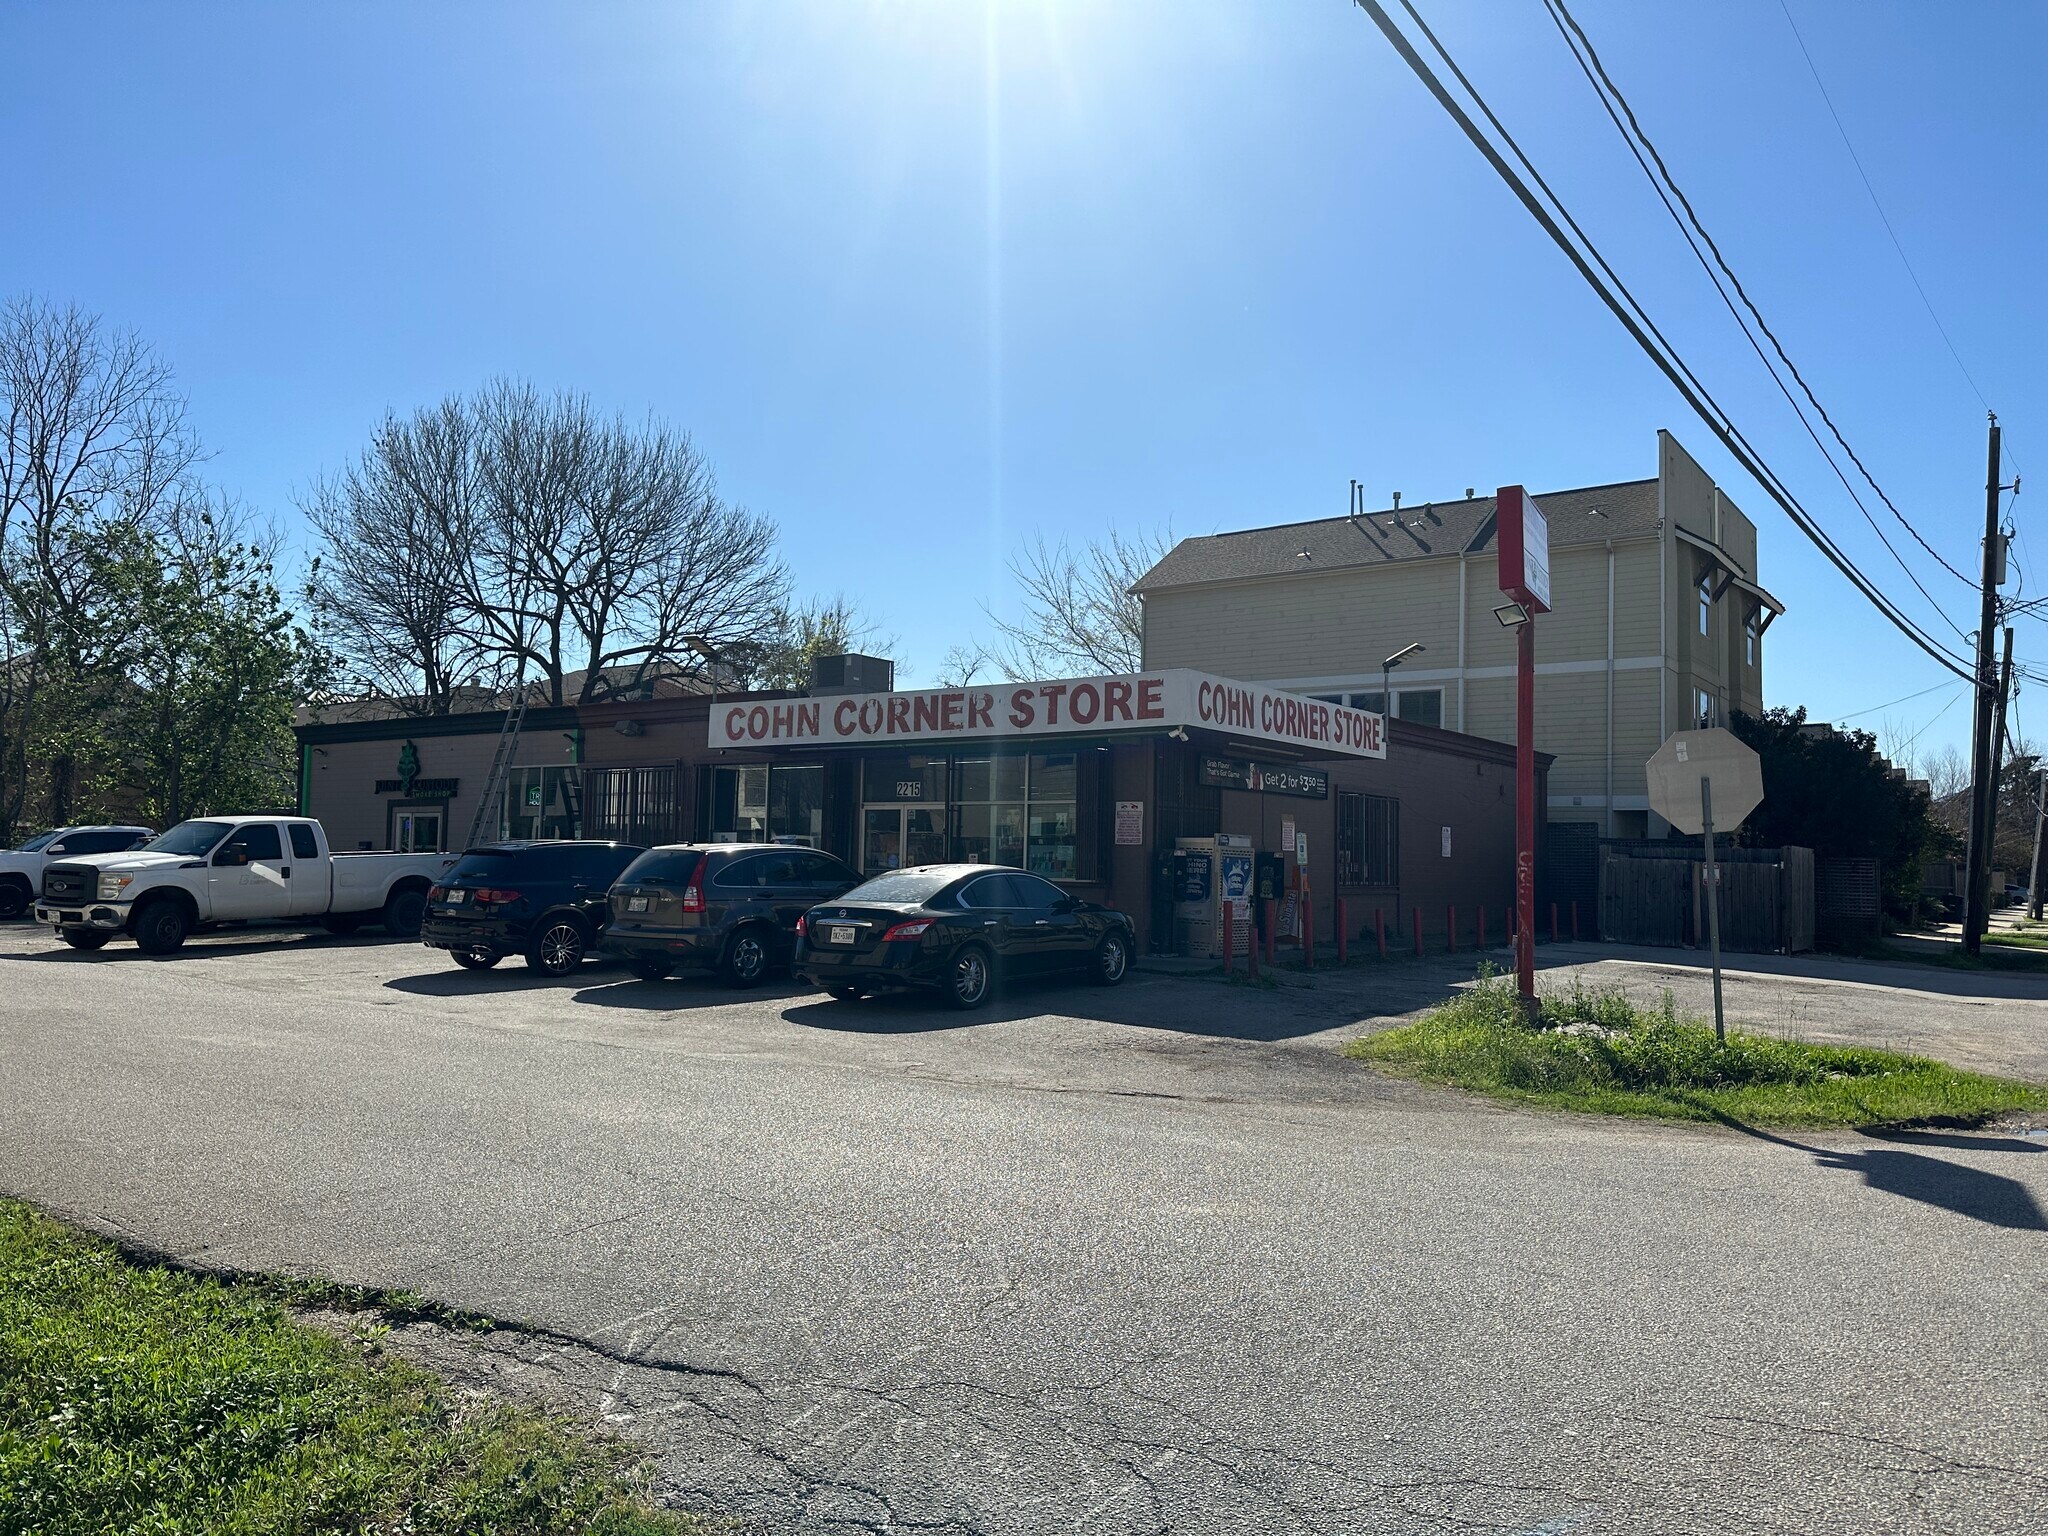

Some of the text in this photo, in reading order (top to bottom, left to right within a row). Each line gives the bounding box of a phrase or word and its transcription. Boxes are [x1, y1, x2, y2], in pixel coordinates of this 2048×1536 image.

[725, 678, 1165, 741] COHN CORNER STORE
[1198, 680, 1380, 751] COHN CORNER STORE
[1206, 759, 1218, 768] Grab
[1219, 769, 1228, 777] Got
[1265, 772, 1279, 785] Get
[1280, 773, 1287, 789] 2
[1288, 775, 1298, 788] for
[434, 790, 450, 798] SHOP
[897, 782, 920, 796] 2215
[1278, 893, 1297, 924] Subasta
